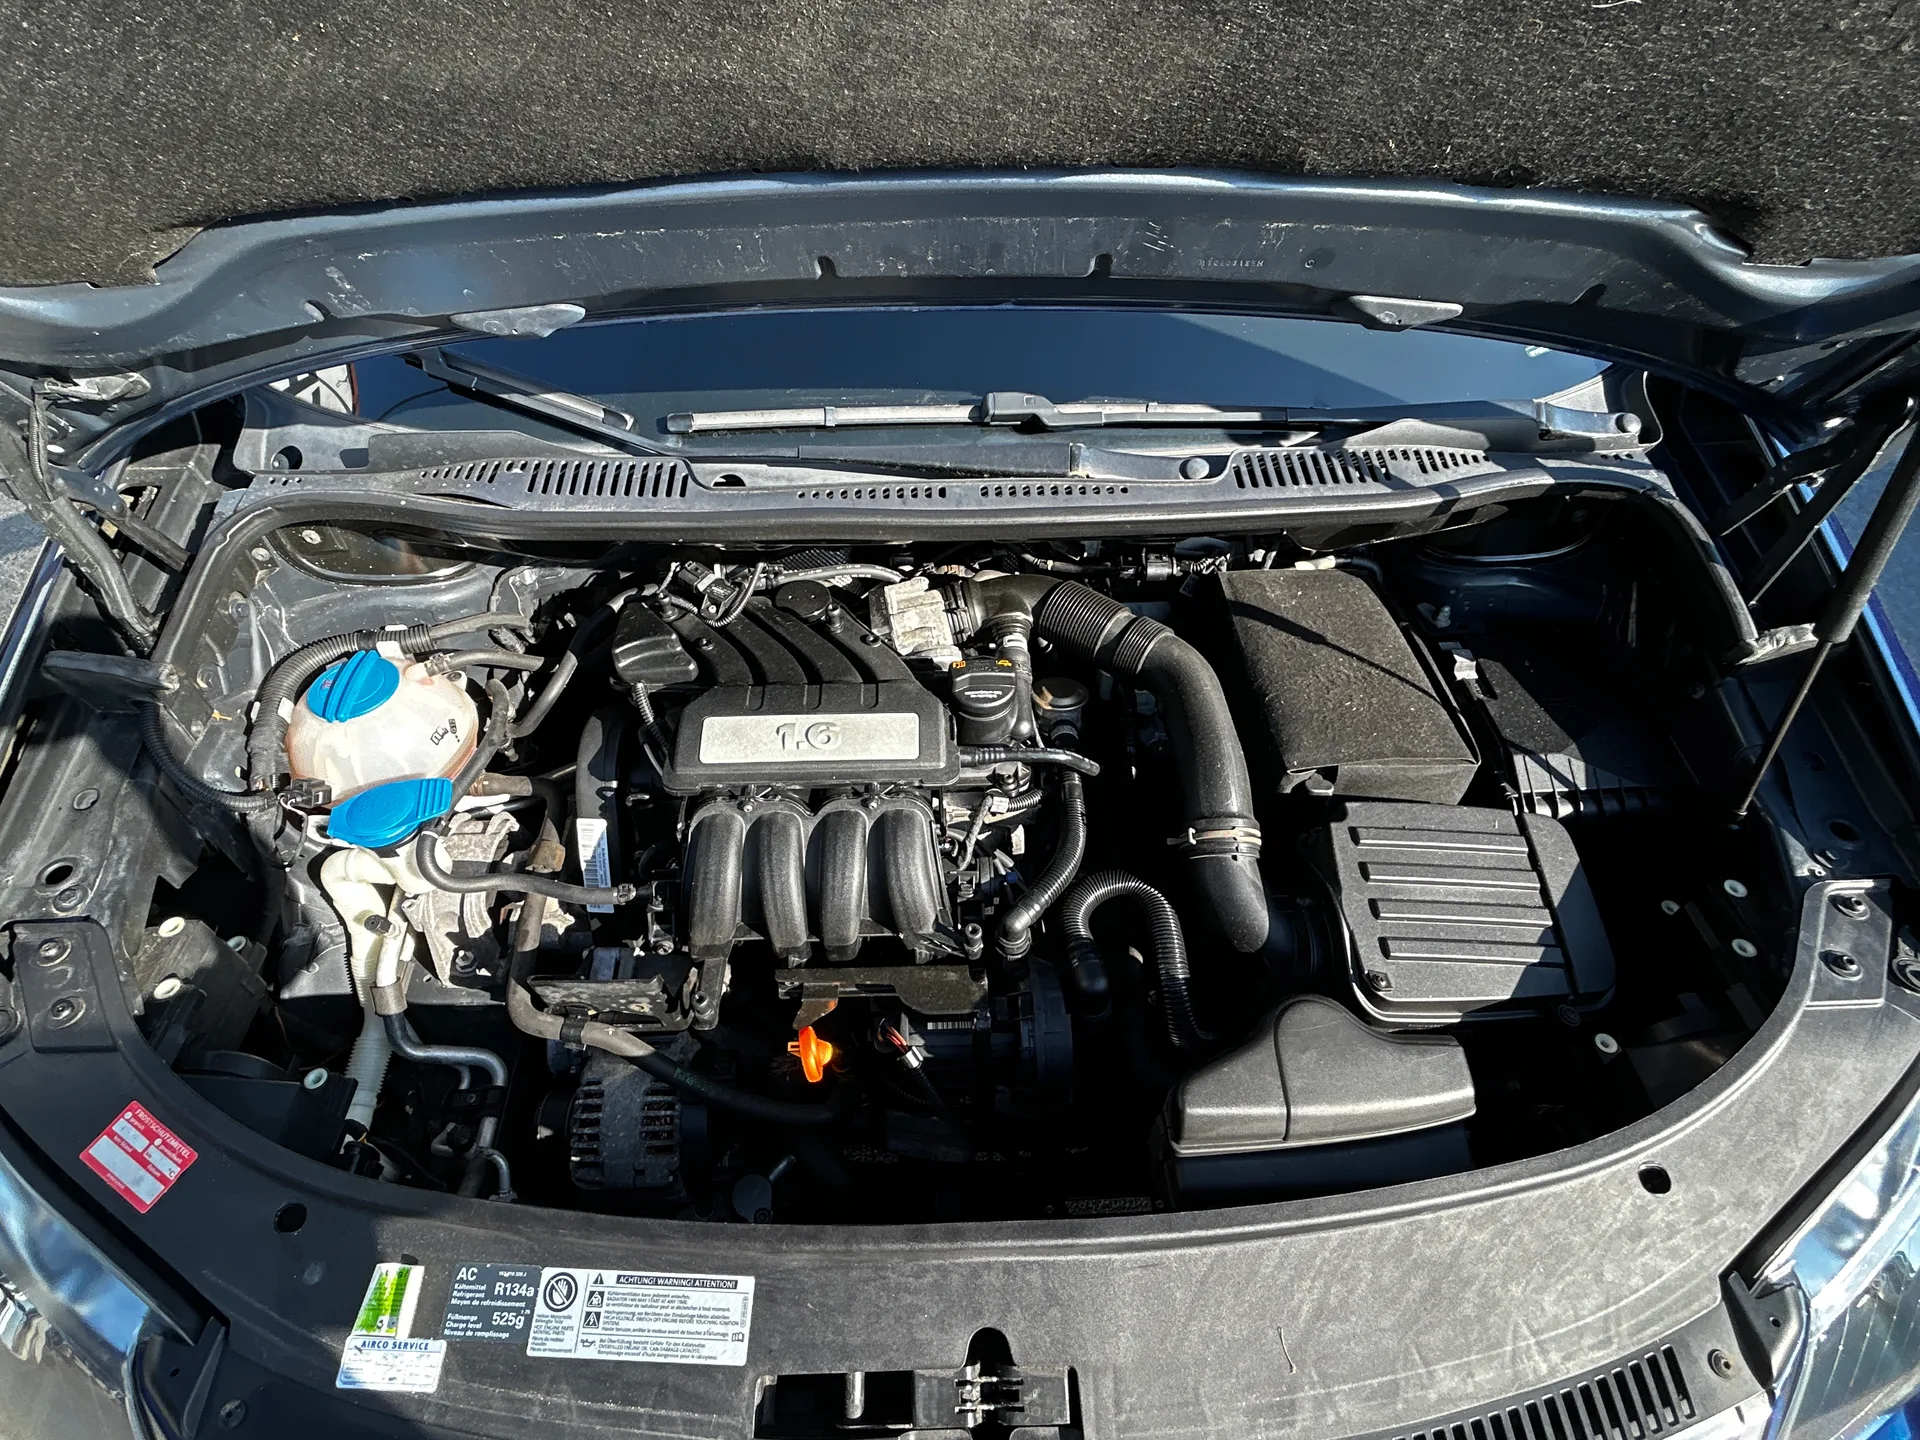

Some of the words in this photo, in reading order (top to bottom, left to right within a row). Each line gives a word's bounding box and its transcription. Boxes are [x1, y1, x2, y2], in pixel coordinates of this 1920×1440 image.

[776, 722, 841, 750] 1.6
[135, 1108, 191, 1159] FROSTSCHUTZMITTEL
[456, 1267, 478, 1280] AC
[619, 1276, 656, 1284] ACHTUNG!
[657, 1278, 693, 1286] WARNING!
[694, 1280, 735, 1288] ATTENTION!
[452, 1290, 485, 1298] Refrigerant
[494, 1282, 535, 1297] R134a
[450, 1298, 471, 1306] Moyen
[446, 1321, 466, 1329] Charge
[492, 1312, 525, 1329] 525g
[474, 1331, 510, 1339] remplissage
[361, 1340, 388, 1349] AIRCO
[392, 1341, 429, 1350] SERVICE
